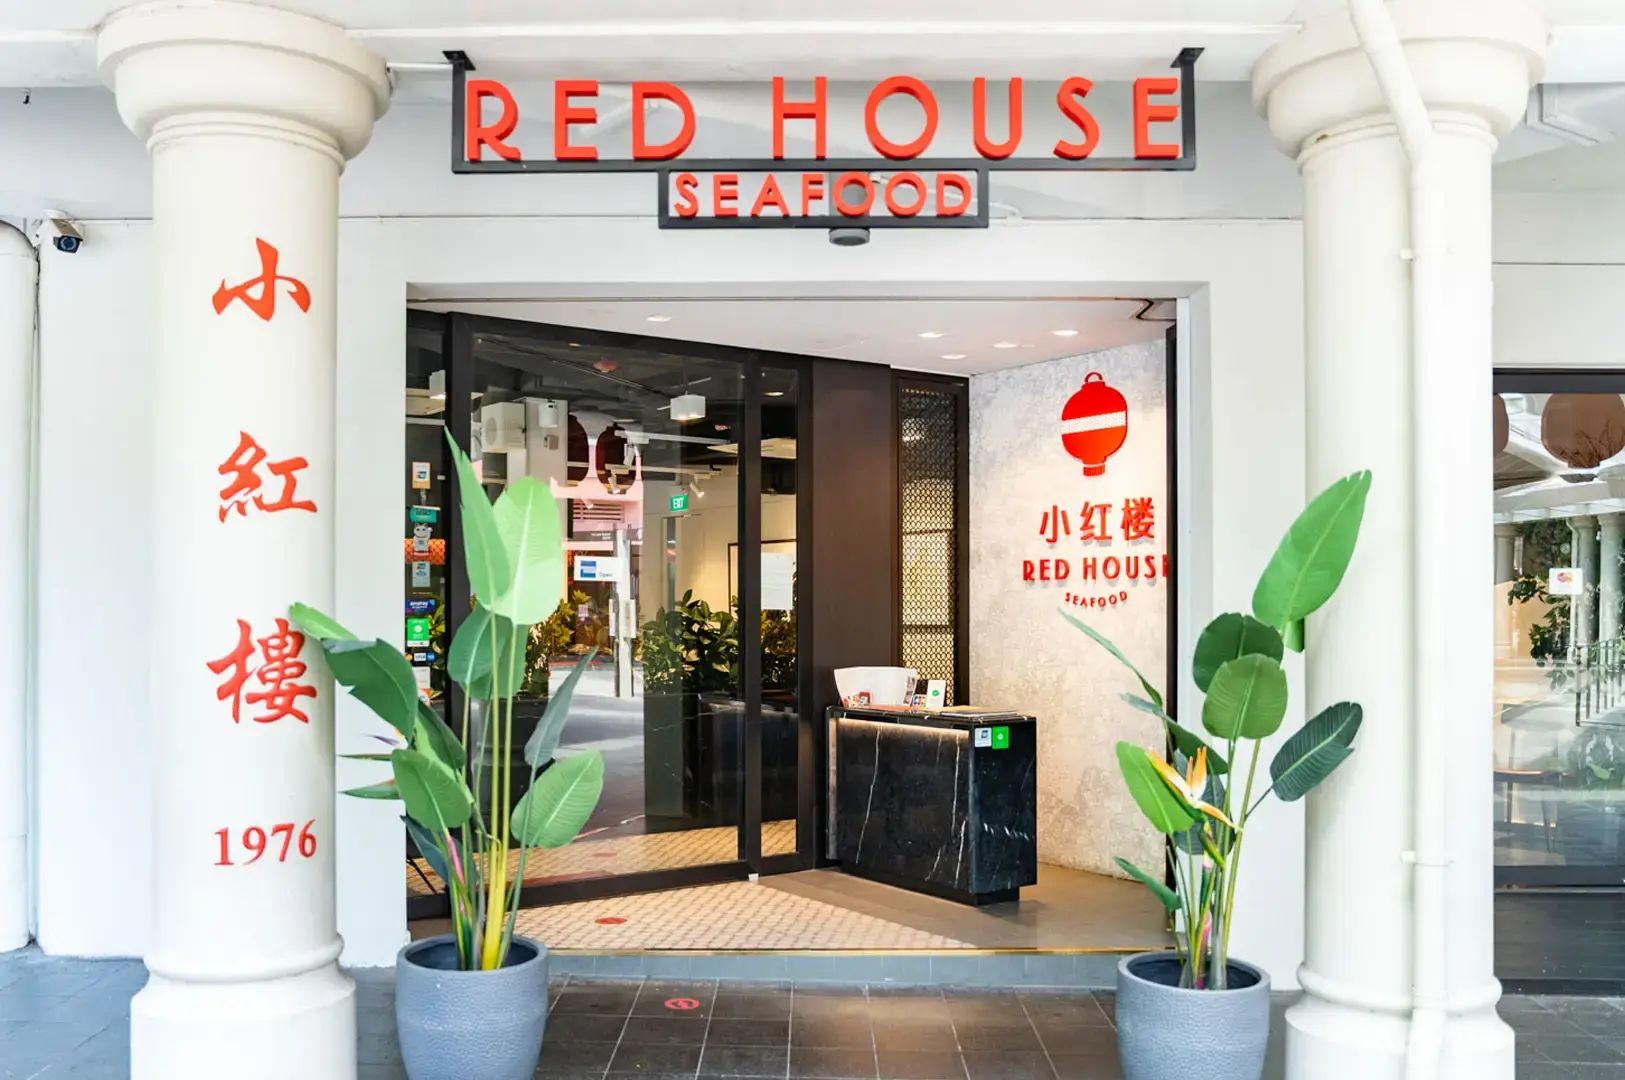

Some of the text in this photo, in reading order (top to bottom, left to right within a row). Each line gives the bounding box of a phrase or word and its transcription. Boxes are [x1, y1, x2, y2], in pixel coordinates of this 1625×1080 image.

[465, 74, 1182, 163] RED HOUSE
[673, 170, 974, 218] SEAFOOD
[207, 237, 318, 724] 小紅樓
[673, 497, 684, 509] EXIT
[1038, 496, 1155, 545] 小红楼
[1022, 558, 1071, 582] RED
[1064, 590, 1129, 608] SEAFOOD
[214, 819, 318, 867] 1976
